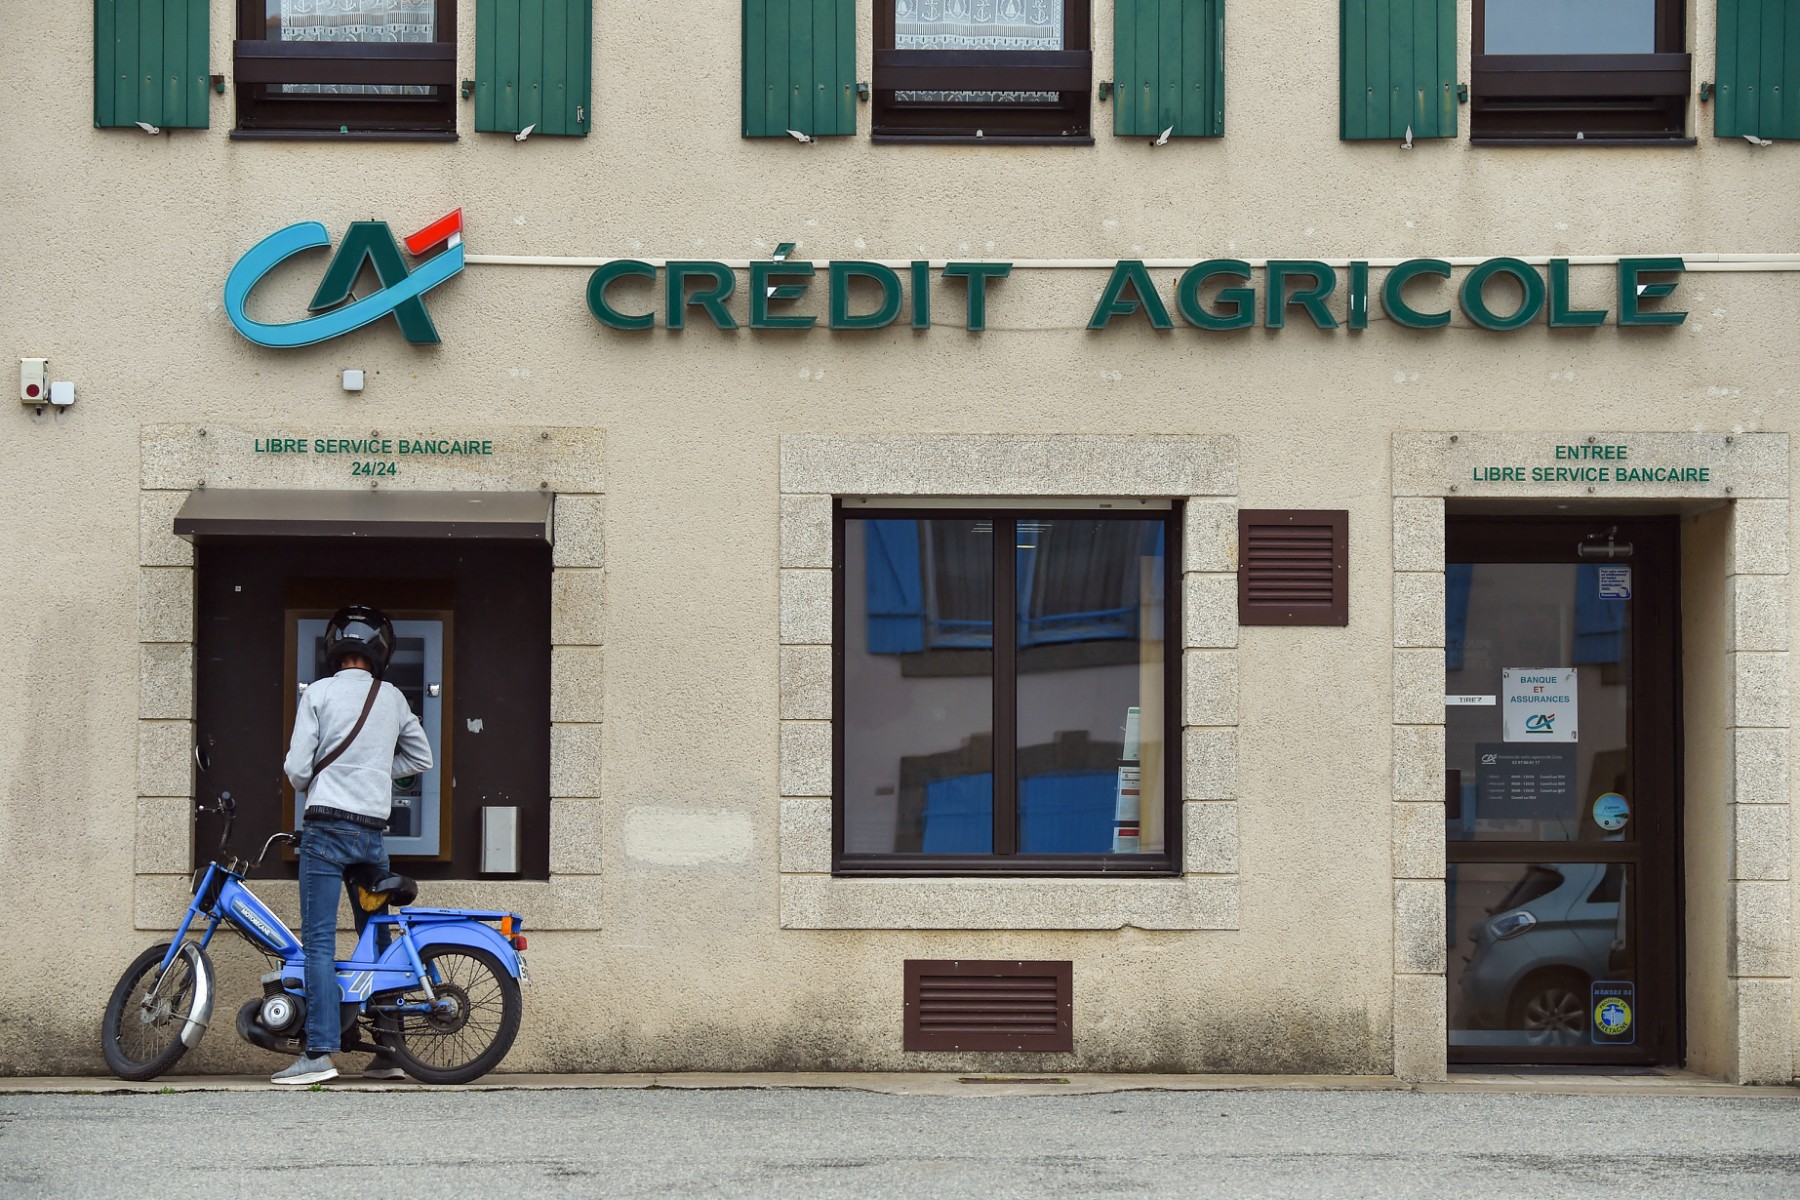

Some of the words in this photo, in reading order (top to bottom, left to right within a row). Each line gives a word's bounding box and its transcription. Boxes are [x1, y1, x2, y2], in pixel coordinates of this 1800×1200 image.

[586, 243, 1014, 331] CRÉDIT
[1086, 257, 1691, 332] AGRICOLE
[254, 438, 308, 453] LIBRE
[314, 439, 393, 454] SERVICE
[399, 440, 493, 455] BANCAIRE
[1555, 445, 1628, 460] ENTREE
[351, 461, 397, 476] 24/24
[1473, 467, 1526, 482] LIBRE
[1531, 467, 1610, 482] SERVICE
[1615, 467, 1710, 482] BANCAIRE
[1520, 676, 1557, 684] BANQUE
[1510, 695, 1570, 703] ASSURANCES
